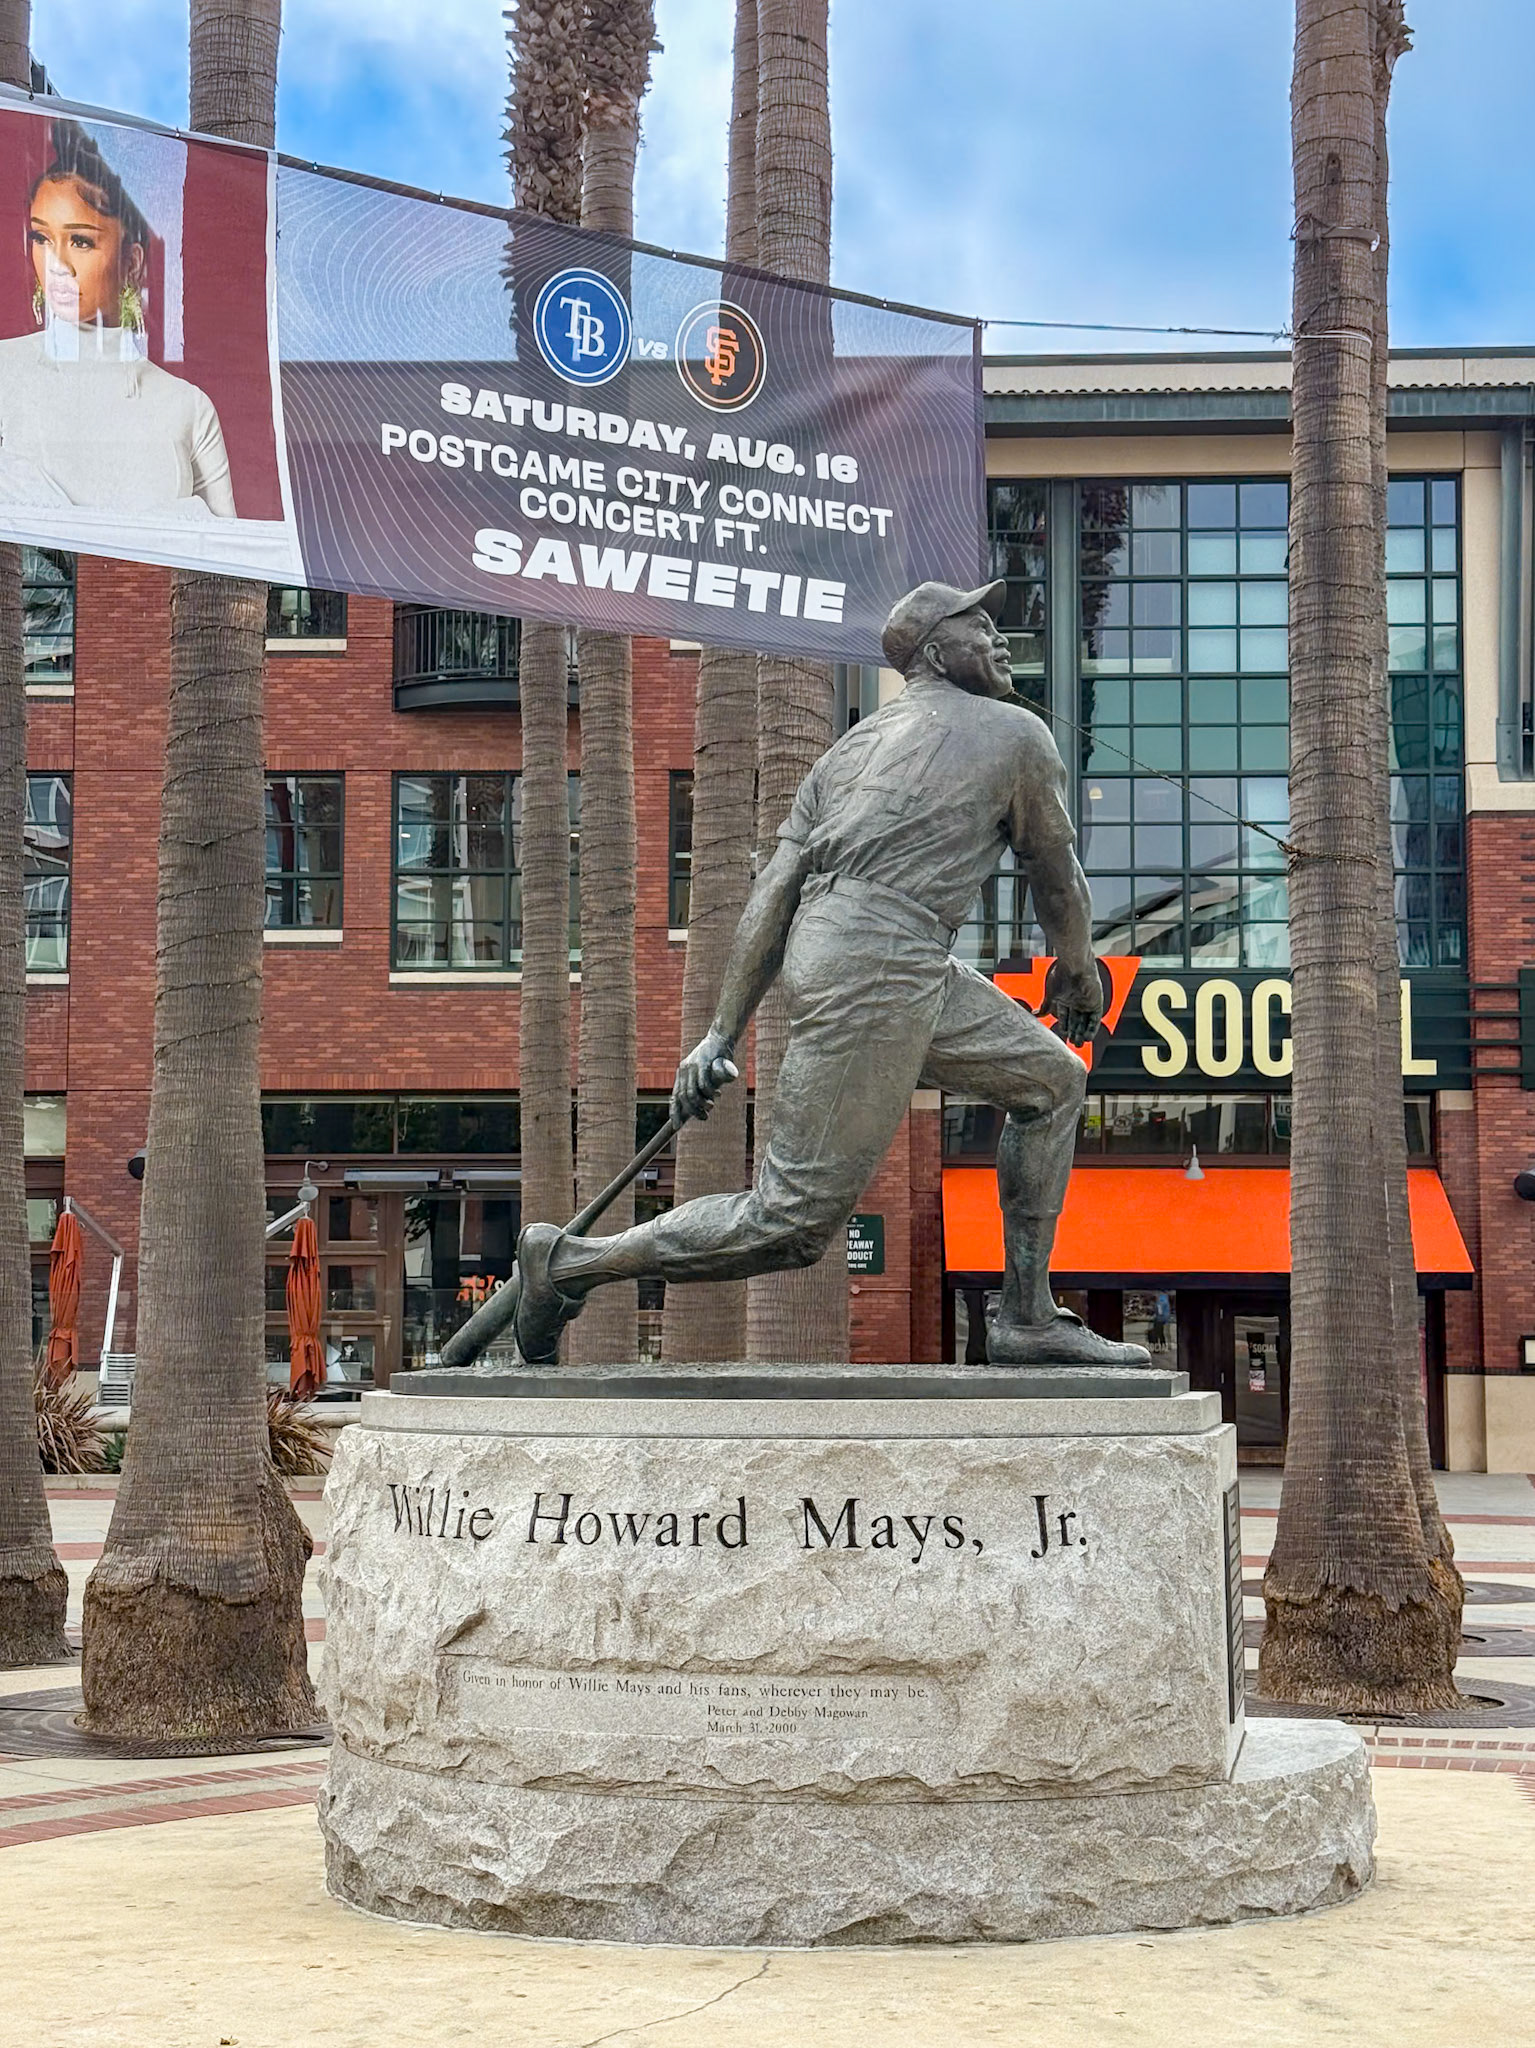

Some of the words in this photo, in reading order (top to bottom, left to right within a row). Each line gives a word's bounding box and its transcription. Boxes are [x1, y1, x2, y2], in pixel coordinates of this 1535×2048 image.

[559, 296, 606, 358] TB
[439, 382, 697, 461] SATURDAY,
[706, 434, 806, 477] AUG.
[815, 452, 859, 484] 16
[380, 423, 606, 493] POSTGAME
[615, 466, 711, 510] CITY
[718, 485, 894, 538] CONNECT
[519, 487, 705, 545] CONCERT
[714, 518, 769, 555] FT.
[471, 528, 847, 624] SAWEETIE
[1141, 979, 1438, 1078] SOCL
[847, 1251, 873, 1260] ODUCT
[849, 1229, 861, 1239] NO
[386, 1483, 494, 1541] Willie
[525, 1492, 749, 1549] Howard
[799, 1497, 984, 1564] Mays,
[1031, 1495, 1088, 1559] Jr.
[462, 1670, 491, 1686] Given
[496, 1677, 506, 1688] in
[512, 1675, 543, 1689] honor
[550, 1677, 562, 1691] of
[569, 1678, 609, 1693] Willie
[616, 1680, 651, 1697] Mays
[657, 1682, 682, 1696] and
[689, 1683, 710, 1697] his
[718, 1683, 751, 1699] fans,
[759, 1685, 822, 1698] wherever
[830, 1685, 861, 1701] they
[869, 1687, 899, 1702] may
[907, 1687, 929, 1699] be.
[707, 1705, 737, 1716] Peter
[742, 1706, 763, 1717] and
[769, 1707, 808, 1720] Debby
[814, 1707, 869, 1720] Magowan
[706, 1722, 742, 1733] March
[768, 1722, 797, 1734] 2000
